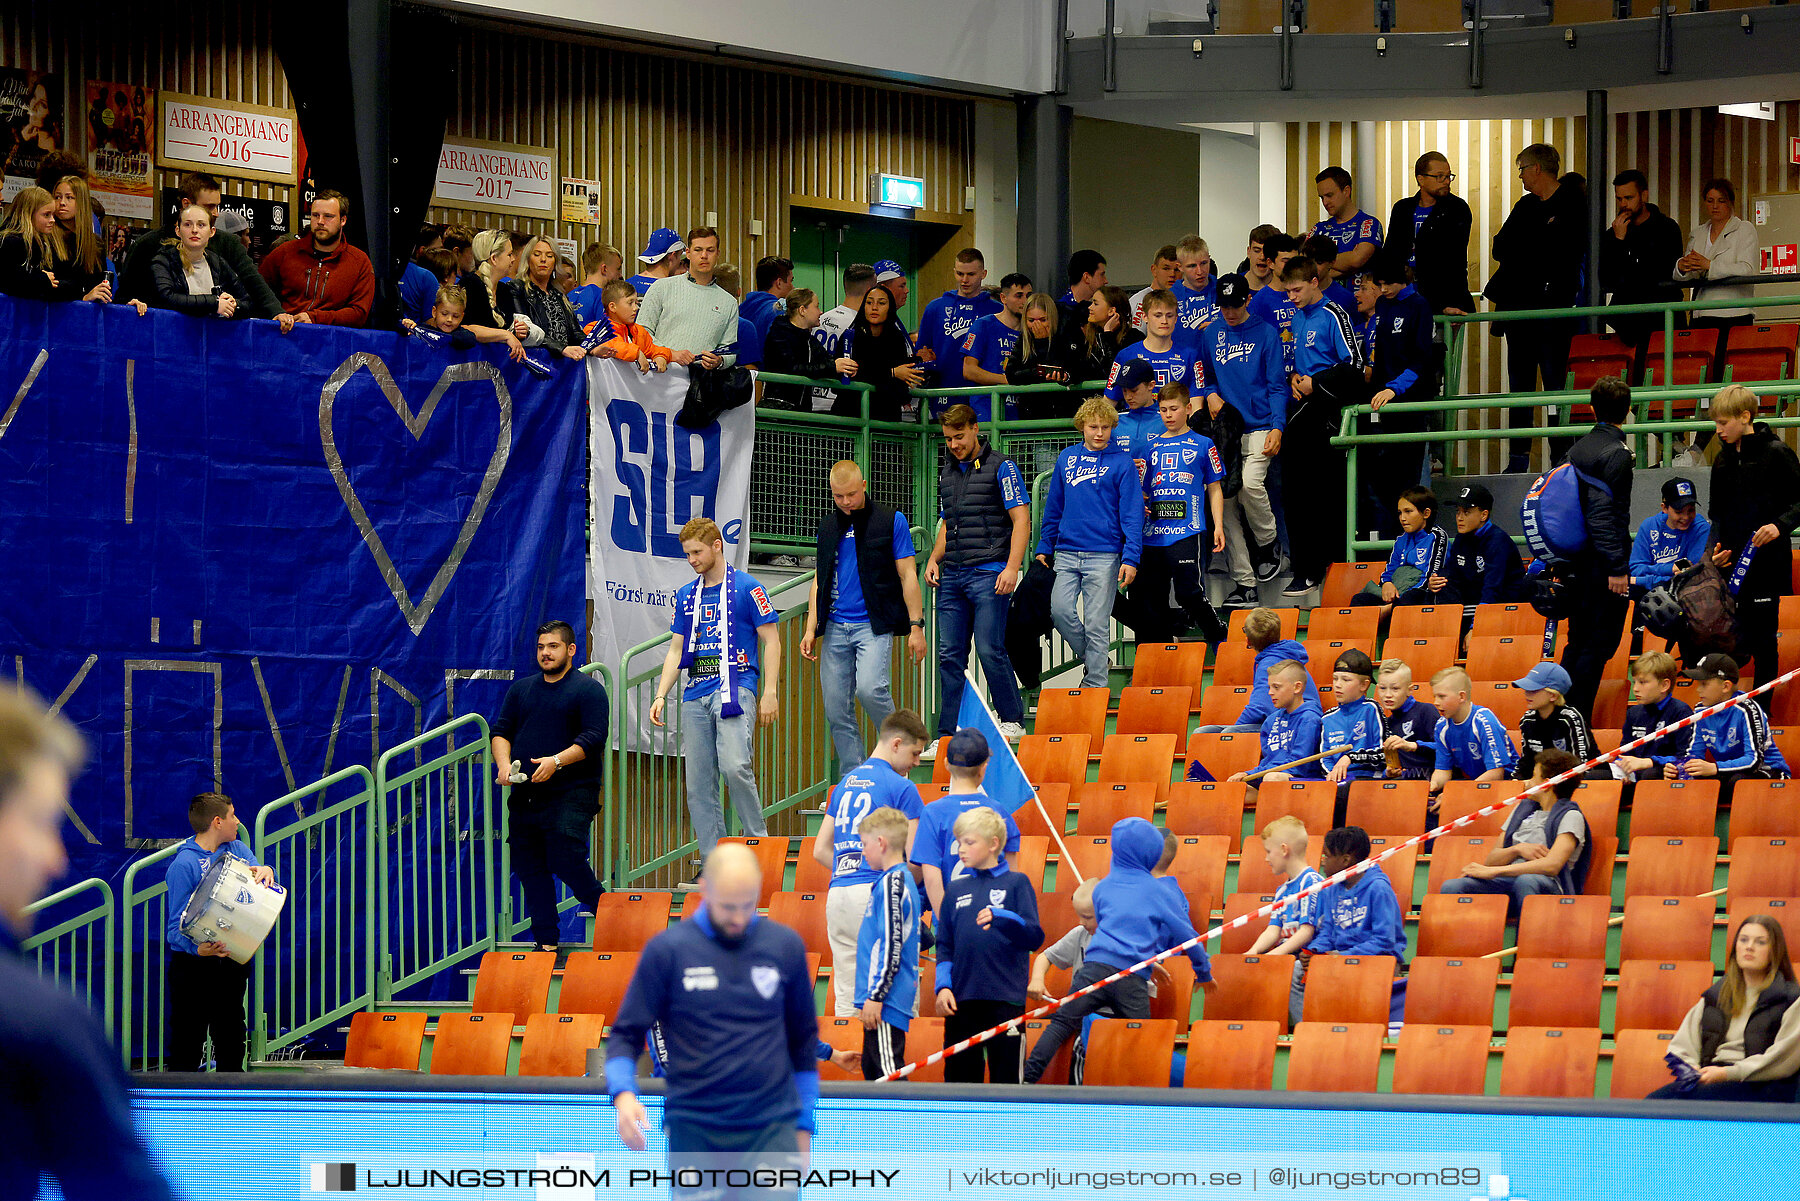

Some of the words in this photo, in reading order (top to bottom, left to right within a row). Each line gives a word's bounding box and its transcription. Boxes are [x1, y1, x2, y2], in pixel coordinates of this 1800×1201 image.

[169, 107, 289, 143] ARRANGEMANG
[208, 137, 251, 163] 2016
[439, 150, 549, 181] ARRANGEMANG
[475, 176, 513, 200] 2017
[998, 337, 1010, 348] 14
[1151, 450, 1159, 466] 8
[605, 398, 722, 558] SLA
[1152, 488, 1187, 497] VOLVO
[1154, 525, 1187, 535] SKÖVDE
[646, 589, 667, 607] när
[752, 586, 772, 615] MAXI
[834, 790, 872, 835] 42
